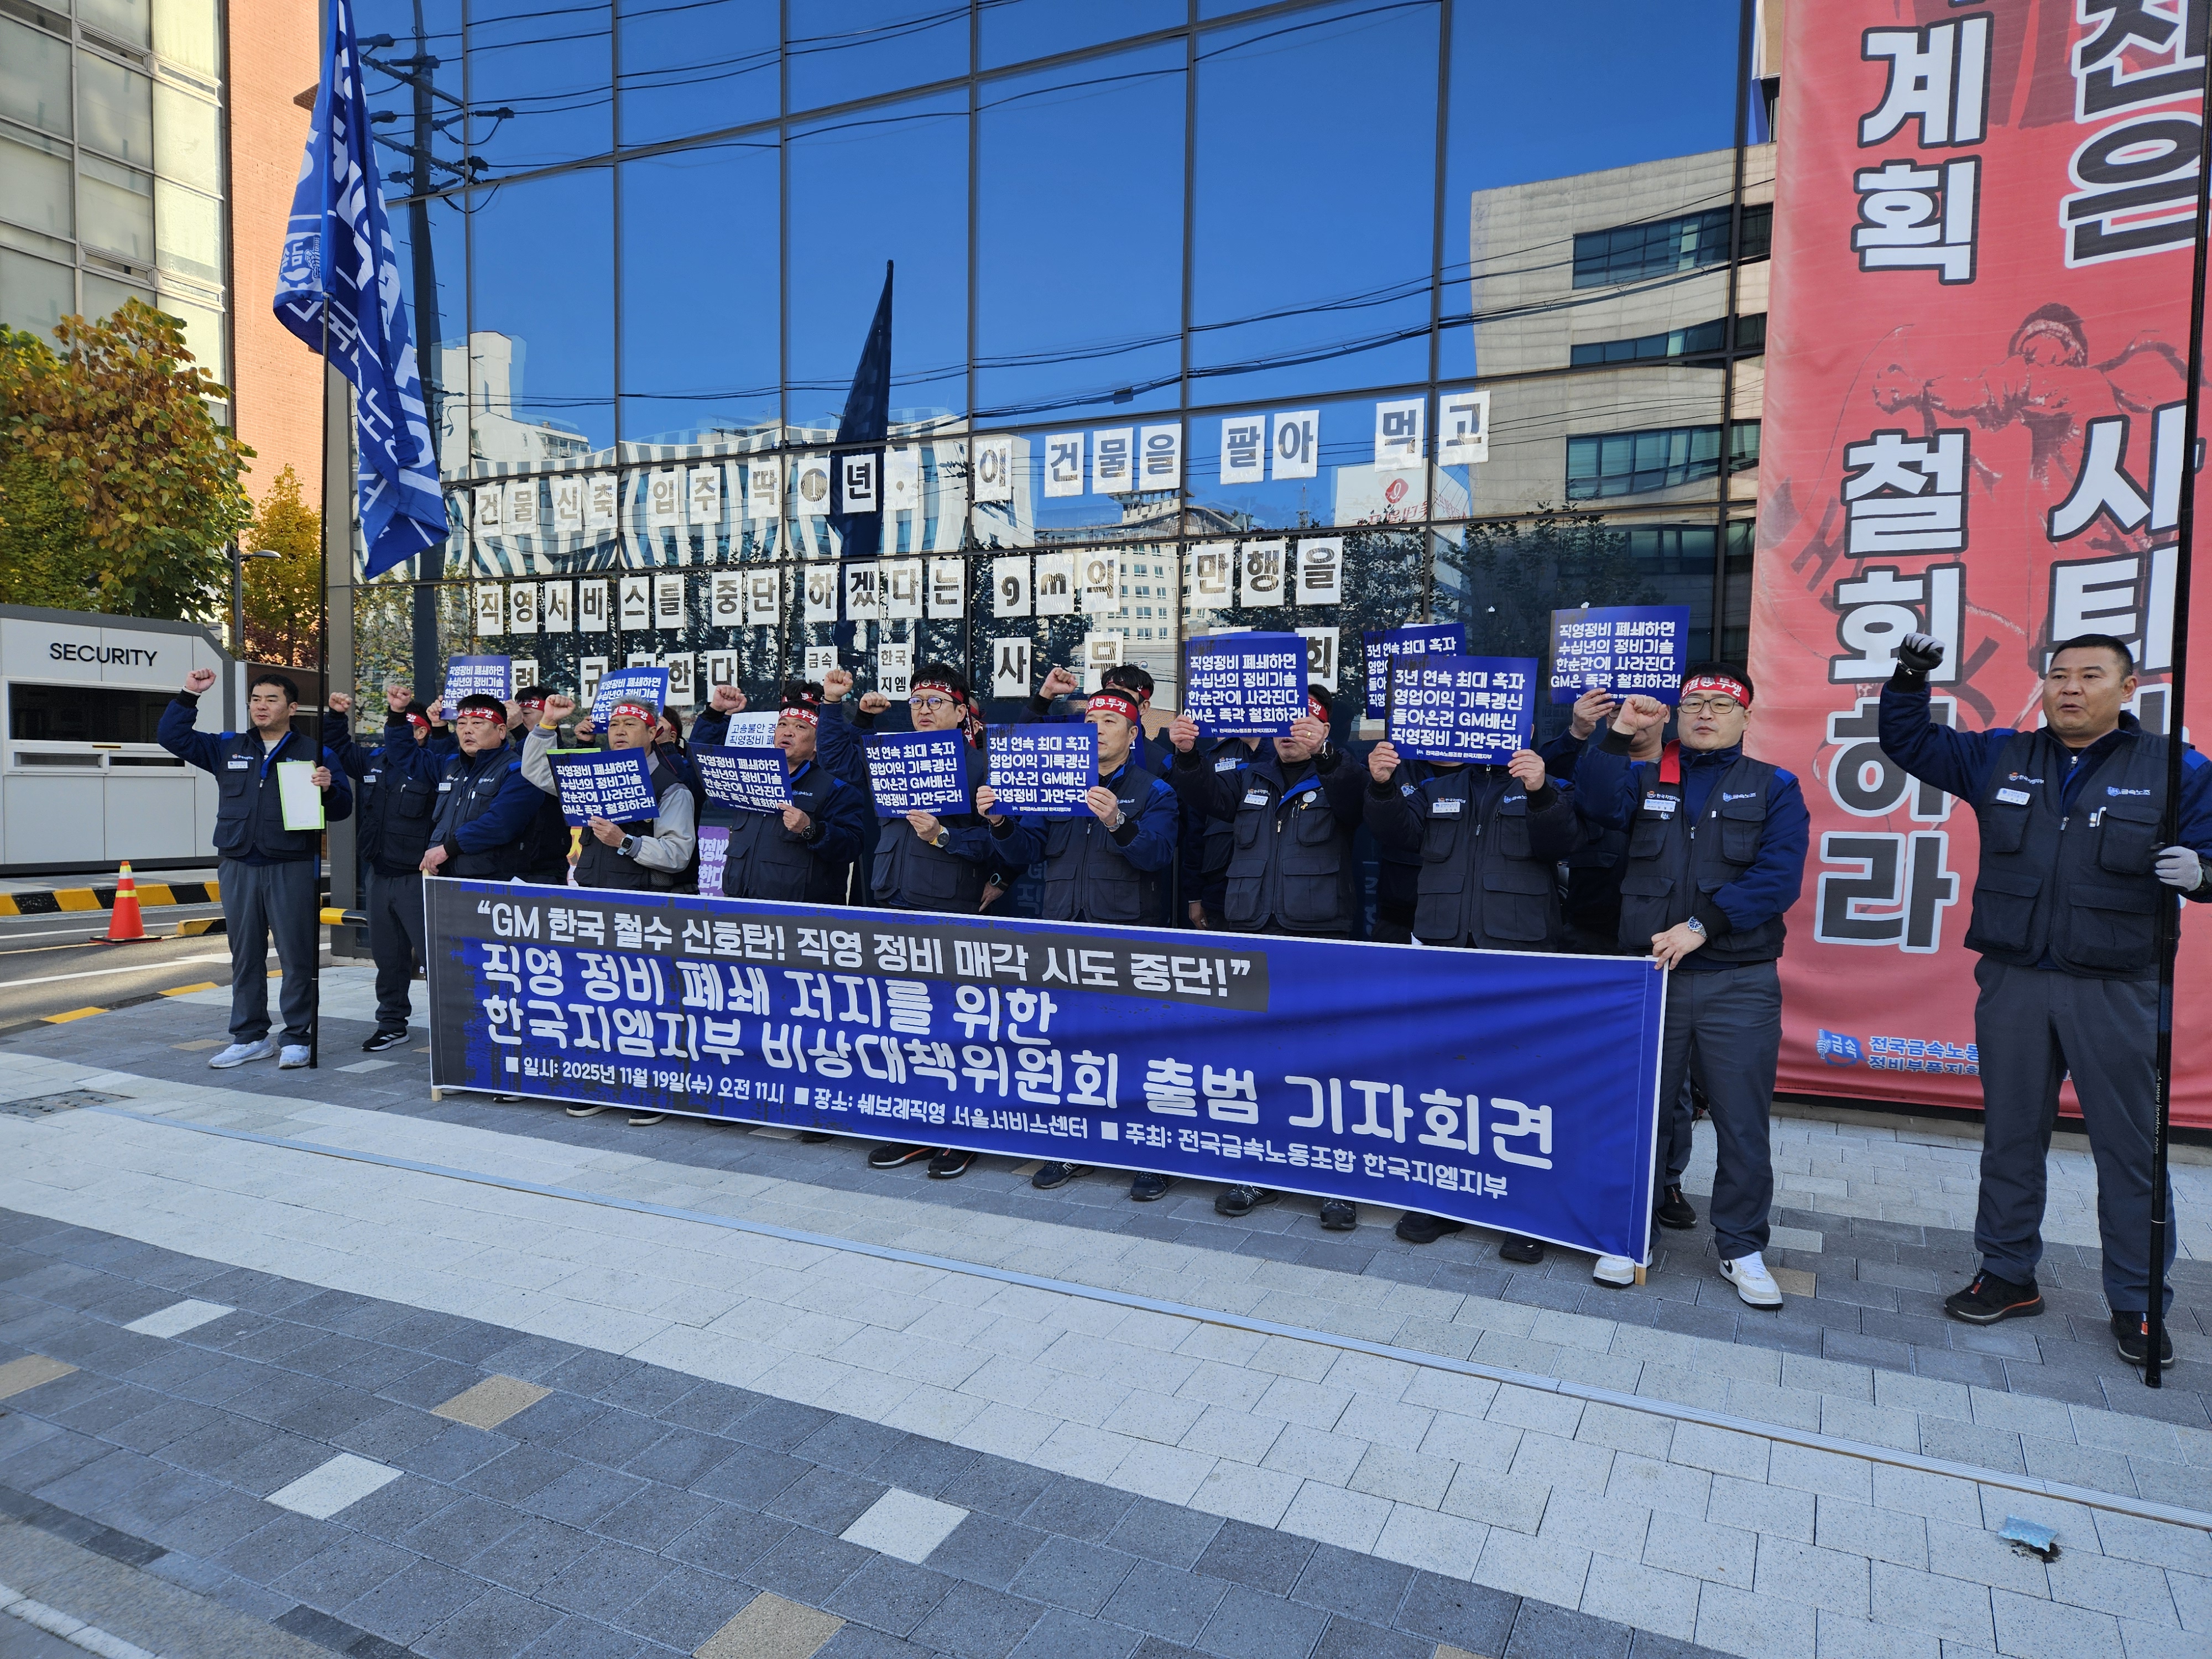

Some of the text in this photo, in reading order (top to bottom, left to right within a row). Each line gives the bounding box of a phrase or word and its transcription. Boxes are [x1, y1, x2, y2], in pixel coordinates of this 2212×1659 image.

[478, 489, 534, 526] 건물
[556, 483, 613, 520] 신축
[653, 477, 717, 513] 입주
[753, 469, 777, 505] 딱
[980, 448, 1007, 488] 이
[1050, 434, 1176, 482] 건물을
[1381, 404, 1483, 453] 먹고
[1814, 11, 1994, 954] 계획 철회하라
[482, 546, 1335, 625] 직영서비스를 중단 하겠다는 만행을
[1559, 622, 1675, 638] 직영정비 폐쇄하면
[49, 643, 157, 666] SECURITY
[1367, 637, 1457, 658] 3년 연속 최대 흑자
[1558, 639, 1674, 655] 수십년의 정비기술
[808, 653, 832, 668] 금속
[881, 650, 906, 666] 한국
[1191, 653, 1296, 671] 직영정비 폐쇄하면
[1557, 656, 1676, 672] 한순간에 사라진다
[450, 665, 504, 676] 직영정비 폐쇄하면
[1368, 660, 1388, 675] 영업
[447, 677, 504, 687] 수십년의 정비기술
[601, 677, 661, 690] 직영정비 폐쇄하면
[881, 676, 906, 692] 지엠
[1190, 671, 1297, 688] 수십년의 정비기술
[1369, 677, 1387, 691] 돌아
[1395, 669, 1526, 690] 3년 연속 최대 흑자
[1551, 673, 1681, 688] GM은 즉각 철회하라!
[1717, 677, 1742, 697] 투쟁
[1107, 698, 1127, 713] 투쟁
[1188, 689, 1300, 706] 한순간에 사라진다
[1369, 693, 1386, 707] 직영
[1394, 689, 1523, 711] 영업이익 기록갱신
[630, 707, 648, 721] 투쟁
[801, 709, 818, 726] 투쟁
[1184, 708, 1215, 723] GM은
[1219, 708, 1245, 723] 즉각
[1392, 708, 1516, 731] 돌아온건 GM배신
[731, 724, 765, 733] 고용불안
[730, 735, 764, 745] 직영정비
[989, 736, 1091, 751] 3년 연속 최대 흑자
[1391, 728, 1522, 750] 직영정비 가만두라!
[867, 742, 956, 760] 3년 연속 최대 흑자
[556, 760, 639, 777] 직영정비 폐쇄하면
[697, 754, 780, 771] 직영정비 폐쇄하면
[869, 758, 957, 775] 영업이익 기록갱신
[990, 754, 1090, 769] 영업이익 기록갱신
[561, 774, 642, 790] 수십년의 정비기술
[702, 767, 782, 785] 수십년의 정비기술
[872, 774, 956, 791] 돌아온건 GM배신
[990, 771, 1087, 786] 돌아온건 GM배신
[562, 785, 646, 802] 한순간에 사라진다
[703, 778, 785, 798] 한순간에 사라진다
[705, 789, 749, 804] GM은 즉각
[992, 789, 1037, 803] 직영정비
[875, 789, 962, 806] 직영정비 가만두라!
[562, 797, 655, 816] GM은 즉각 철회하라!
[549, 907, 606, 946] 한국
[614, 912, 672, 951] 철수
[682, 918, 785, 961] 신호탄!
[797, 928, 863, 966] 직영
[873, 934, 943, 975] 정비
[954, 941, 1029, 982] 매각
[1042, 947, 1118, 987] 시도
[482, 943, 1057, 1046] 직영 정비 폐쇄 저지를 위한
[482, 994, 1553, 1170] 한국지엠지부 비상대책위원회 출범 기자회견
[524, 1057, 1507, 1199] 일시: 2025년 11월 19일(수) 오전 11시 장소: 쉐보레직영 서울서비스센터 주최: 전국금속노동조합 한국지엠지부
